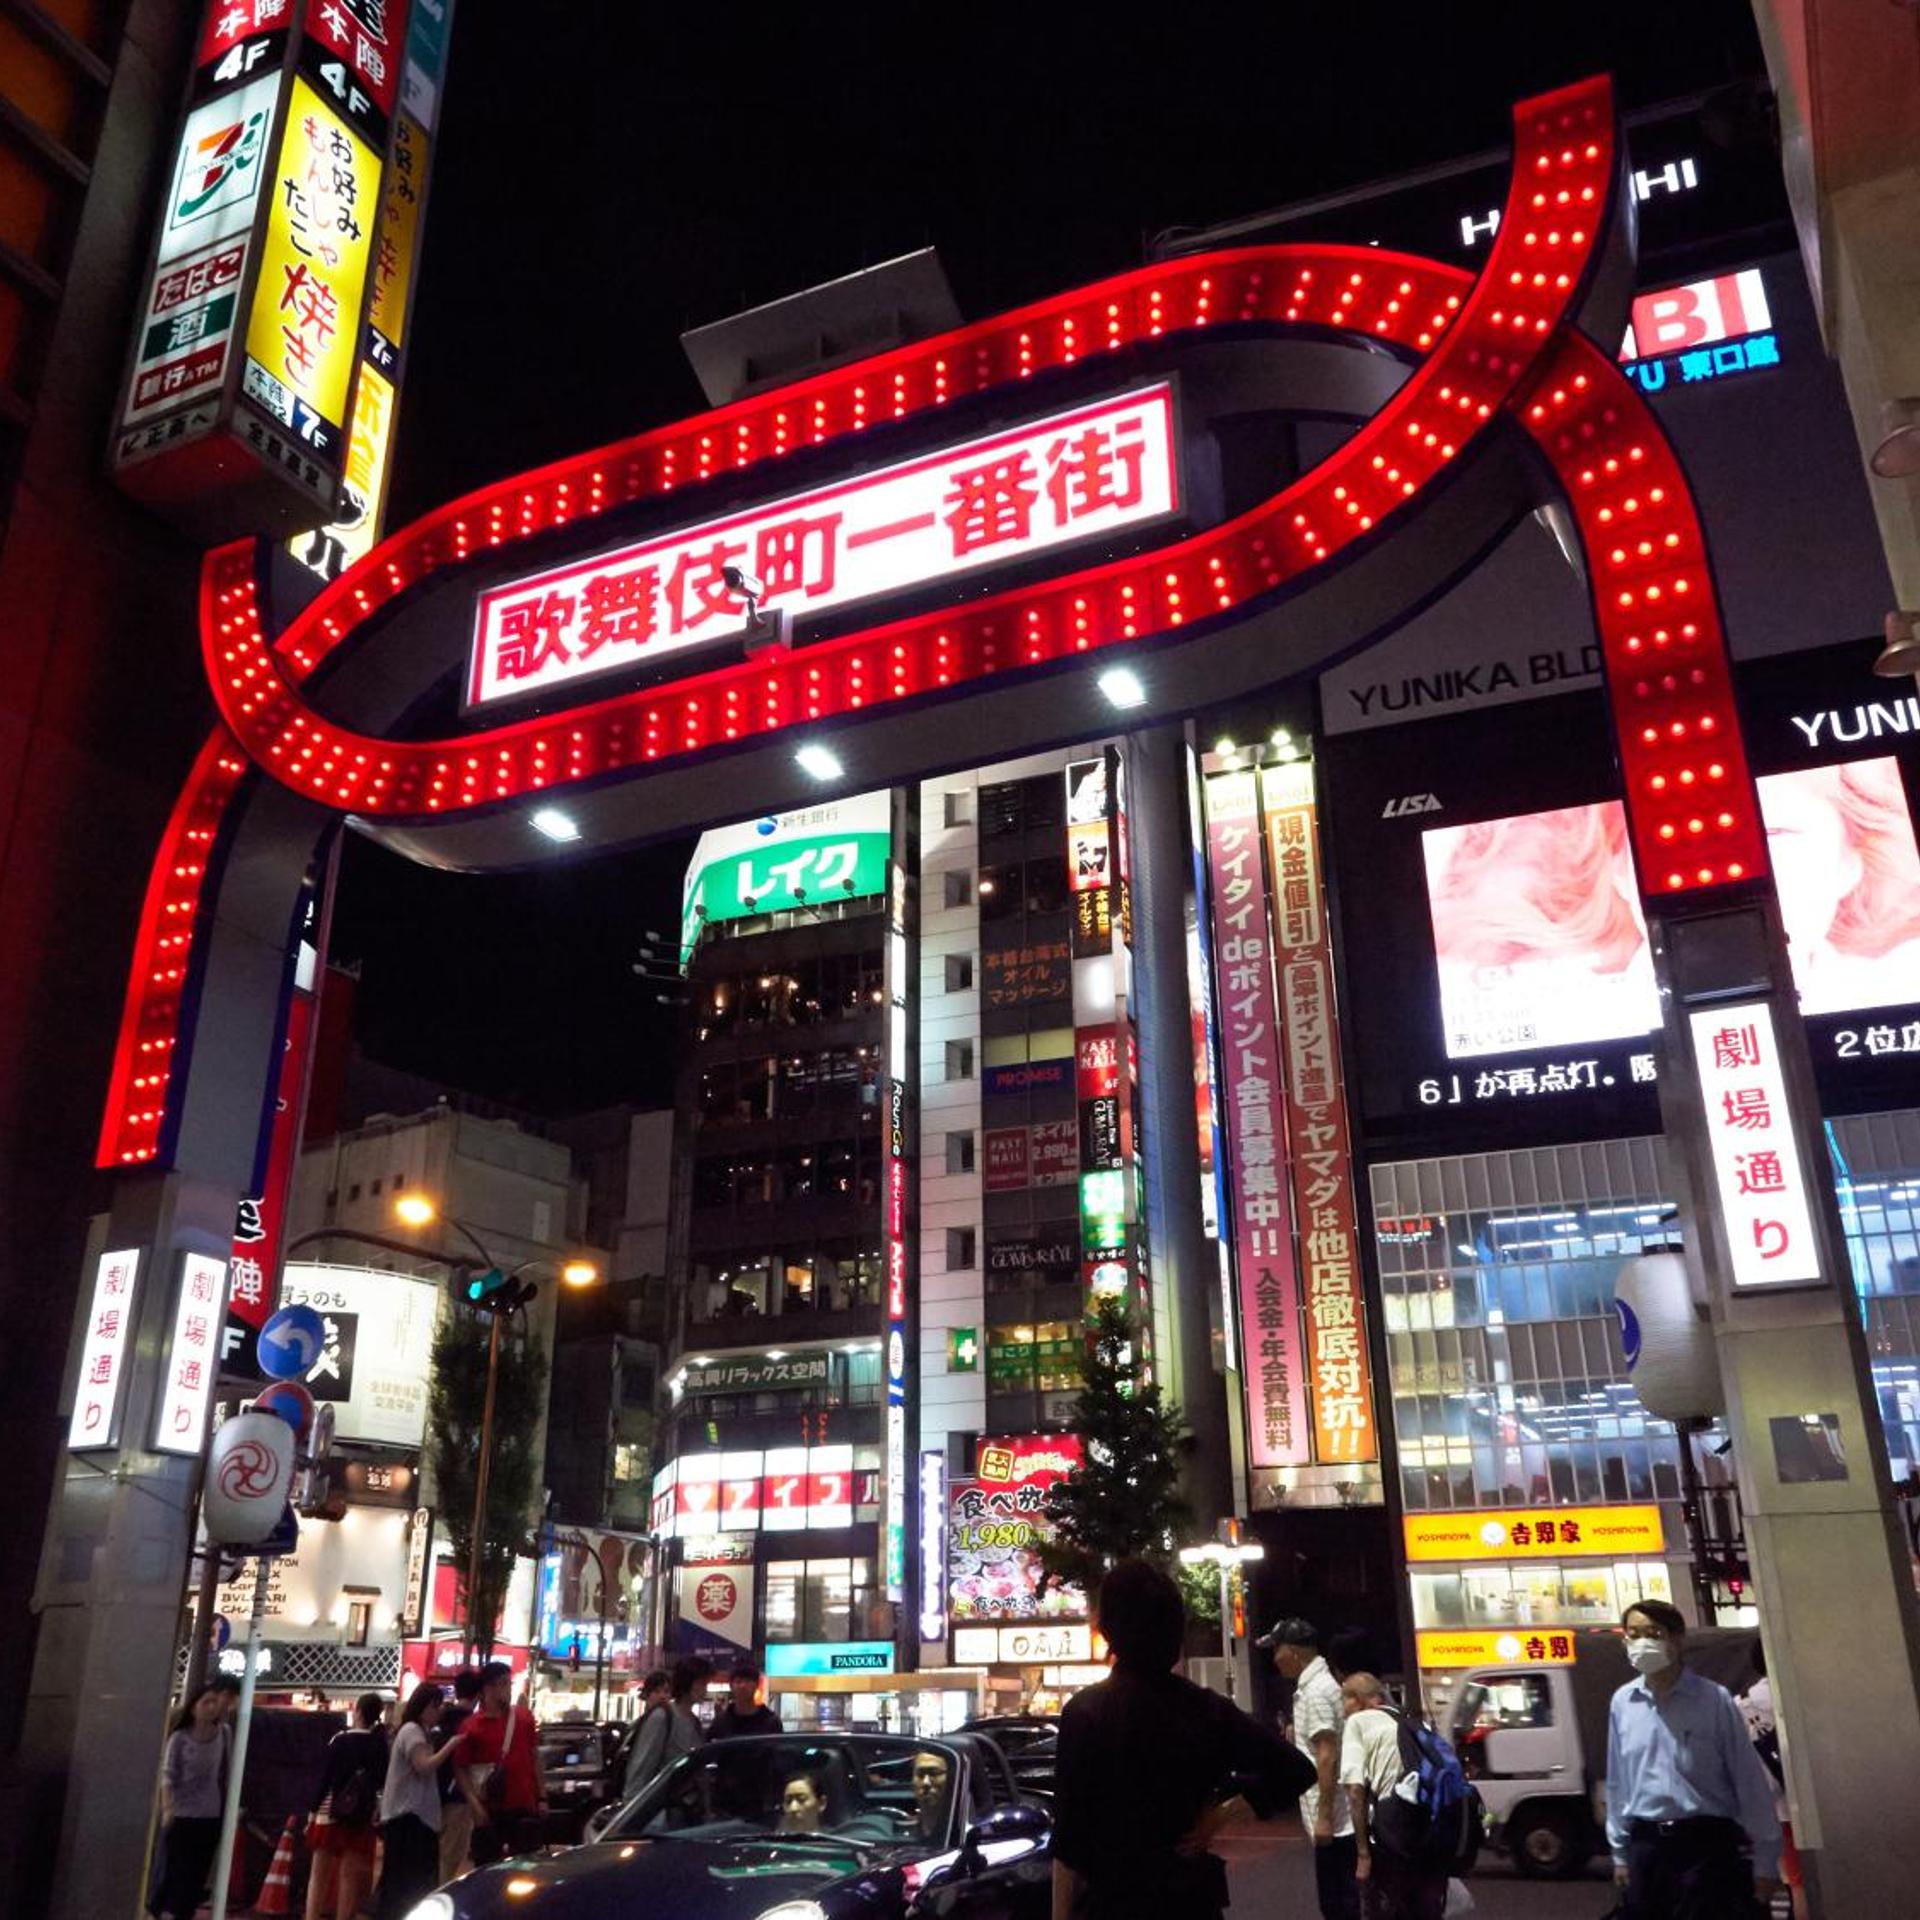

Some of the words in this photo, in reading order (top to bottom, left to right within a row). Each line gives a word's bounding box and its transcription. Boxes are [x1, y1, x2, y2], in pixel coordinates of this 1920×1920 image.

[214, 40, 270, 81] 4F
[320, 62, 370, 114] 4F
[154, 251, 240, 314] たばこ
[165, 305, 211, 351] 酒
[371, 329, 393, 364] 7F
[299, 402, 330, 449] 7F
[496, 414, 1151, 684] 歌舞伎町一番街
[1349, 661, 1519, 716] YUNIKA
[736, 841, 859, 905] レイク
[1712, 1023, 1790, 1260] 劇場通り
[86, 1263, 129, 1431] 劇場通り
[174, 1270, 216, 1434] 劇場通り
[1510, 1519, 1581, 1546] 吉野家
[834, 1656, 884, 1668] PANDORA
